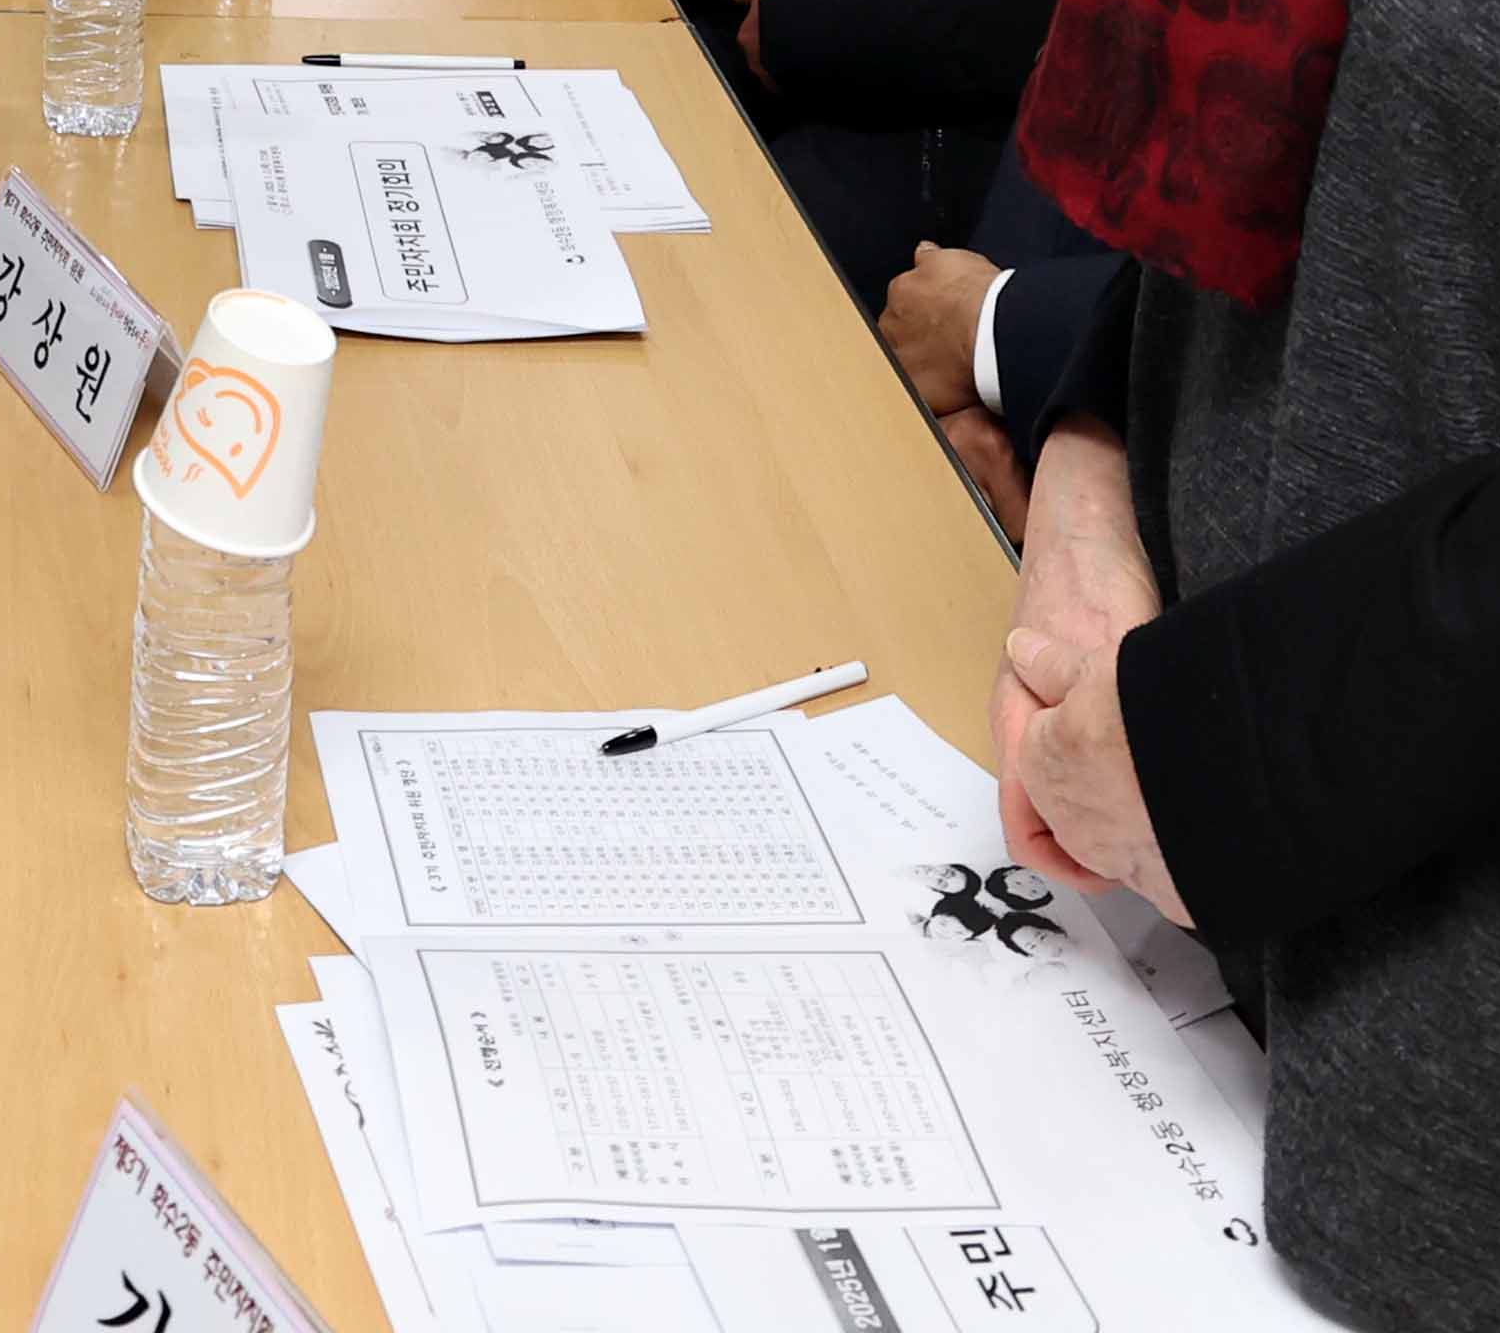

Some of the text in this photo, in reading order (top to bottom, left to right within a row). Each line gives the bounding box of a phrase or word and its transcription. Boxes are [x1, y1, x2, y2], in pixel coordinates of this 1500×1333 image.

[375, 157, 434, 294] 주민자치회 정기회의
[1060, 988, 1225, 1202] 화수2동 행정복지센터
[151, 1183, 202, 1257] 화수2동
[823, 1257, 884, 1330] 2025년
